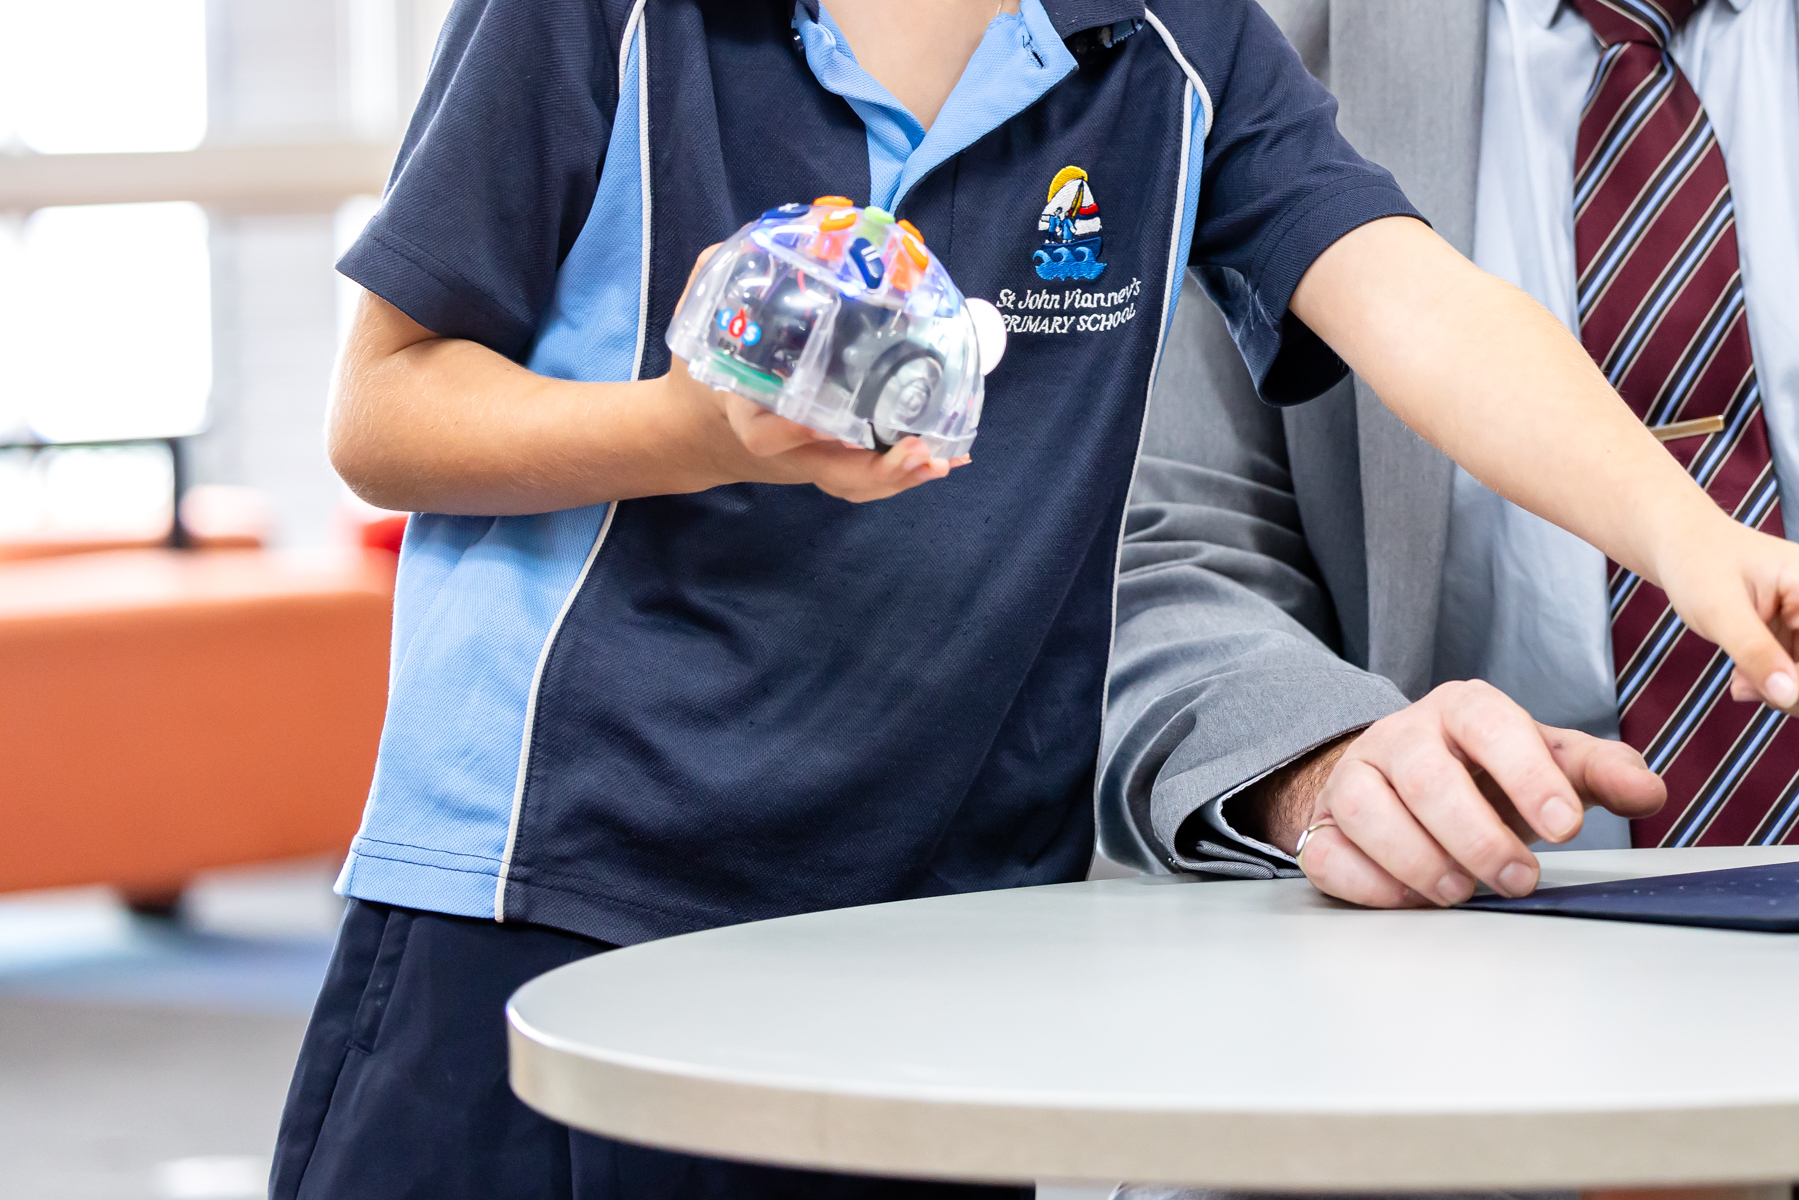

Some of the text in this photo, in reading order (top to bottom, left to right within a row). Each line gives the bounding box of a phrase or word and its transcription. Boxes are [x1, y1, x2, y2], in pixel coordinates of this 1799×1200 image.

[996, 277, 1141, 310] St John Vianney's
[720, 310, 758, 342] tts
[1076, 302, 1136, 332] SCHOOL
